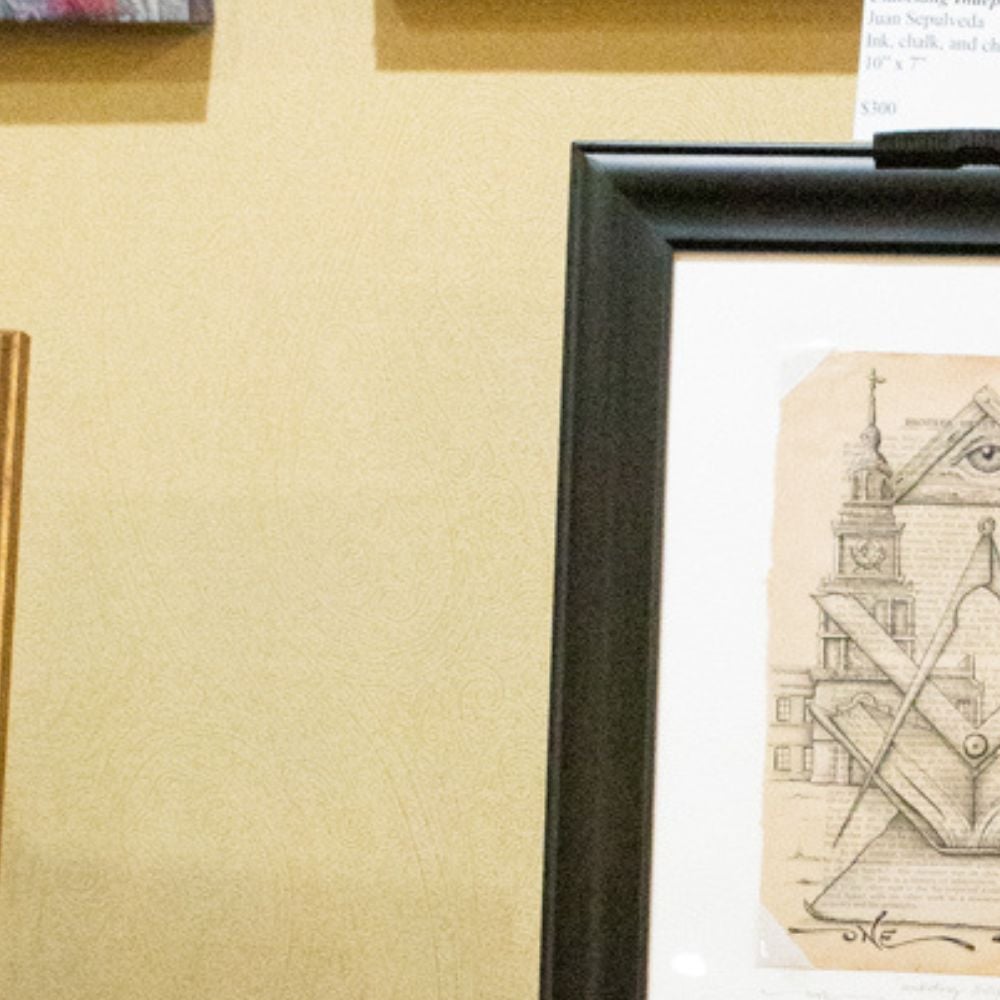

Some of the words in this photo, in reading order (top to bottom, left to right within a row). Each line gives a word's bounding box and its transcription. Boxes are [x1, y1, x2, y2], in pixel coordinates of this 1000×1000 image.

[868, 11, 900, 26] Juan
[905, 12, 985, 28] Sepulveda
[867, 33, 894, 49] Ink,
[898, 34, 943, 51] chalk,
[949, 37, 978, 51] and
[895, 59, 903, 71] x
[860, 100, 897, 116] $300
